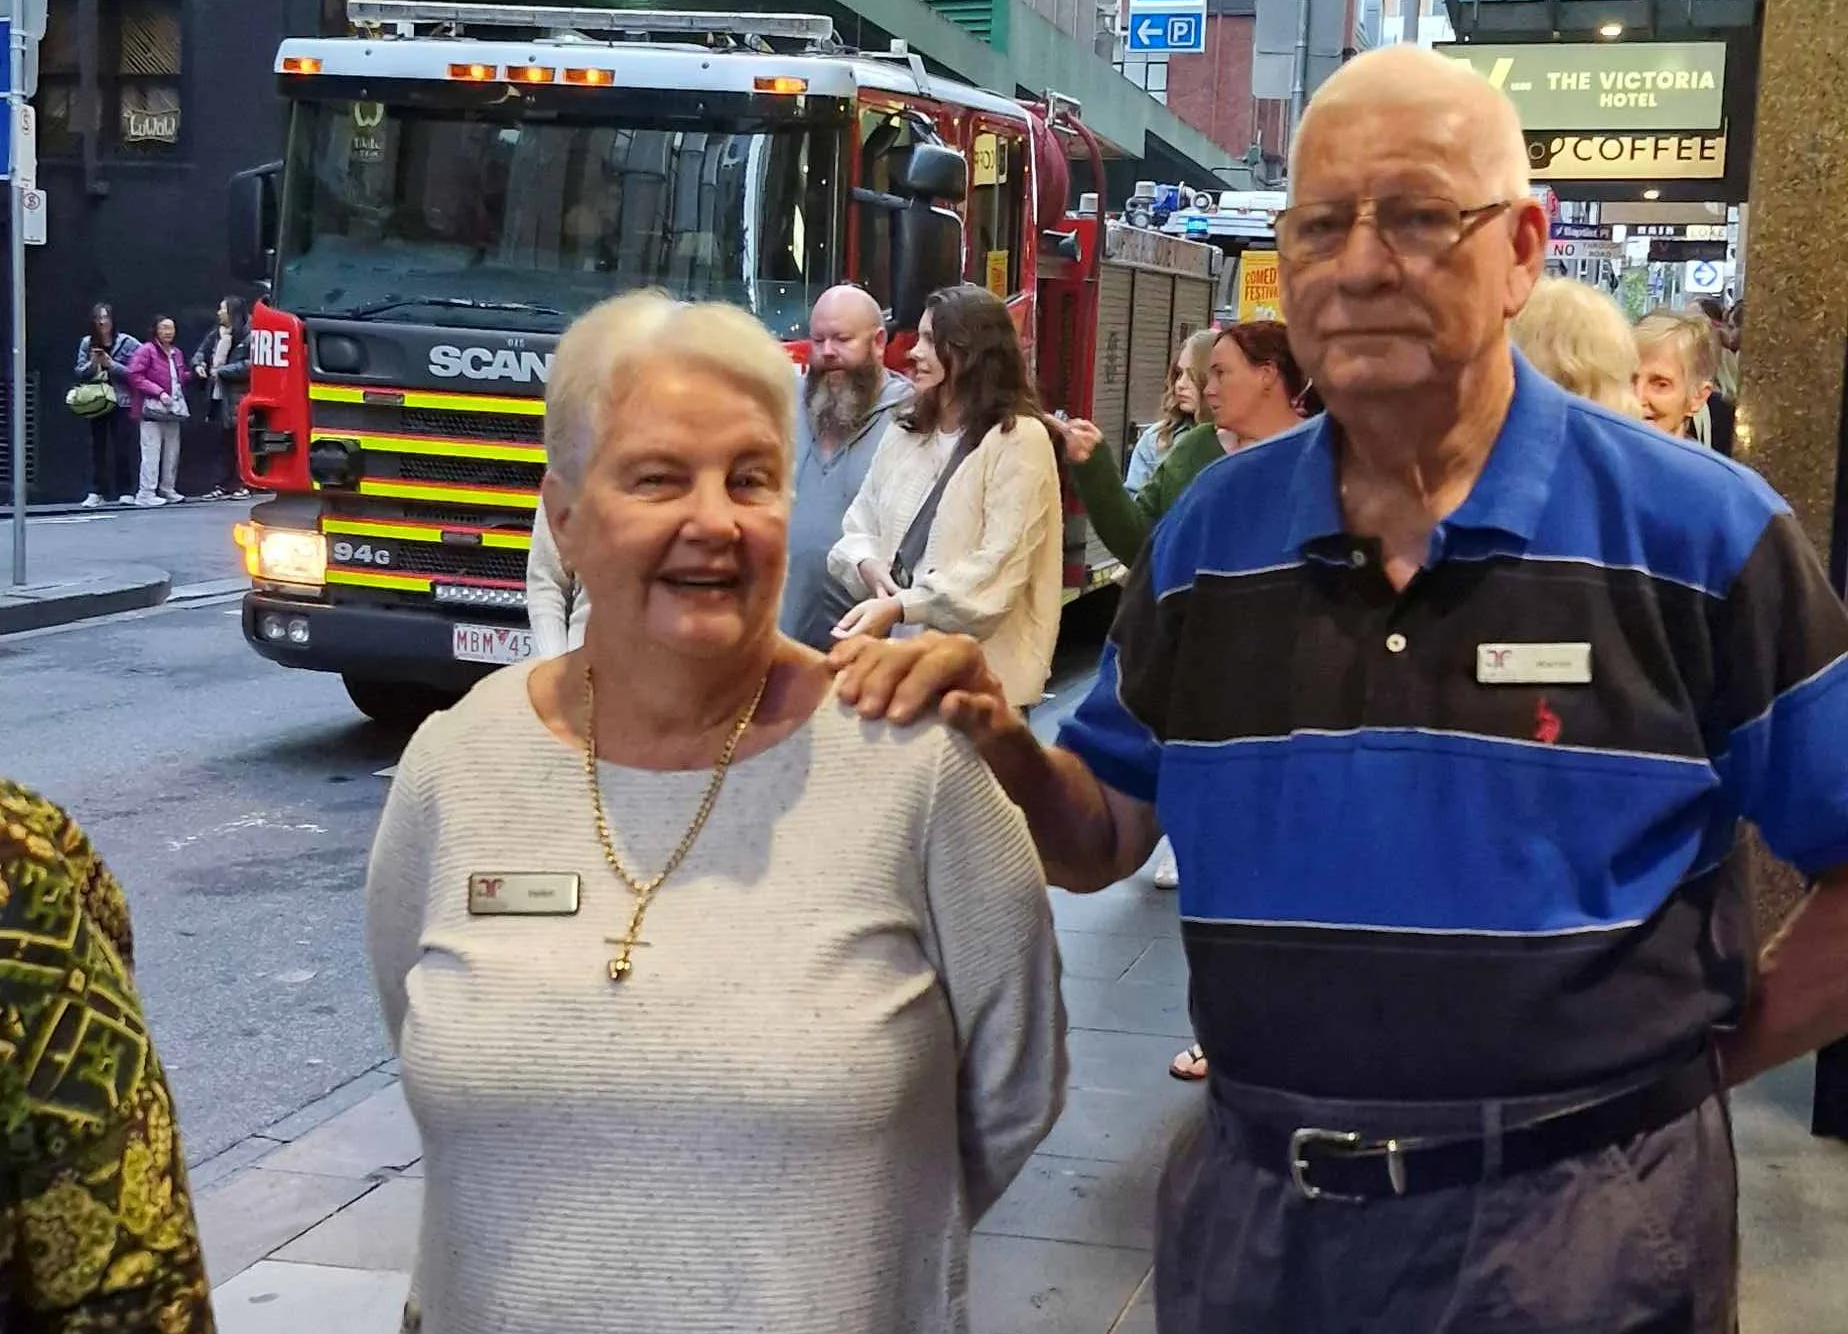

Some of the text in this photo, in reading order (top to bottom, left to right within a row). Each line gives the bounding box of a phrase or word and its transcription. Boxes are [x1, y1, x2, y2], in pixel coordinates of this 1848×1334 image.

[1173, 22, 1188, 42] P
[1547, 71, 1715, 90] THE VICTORIA
[1600, 93, 1658, 107] HOTEL
[1573, 136, 1716, 161] COFFEE
[1554, 244, 1575, 256] NO
[457, 630, 494, 653] MBM
